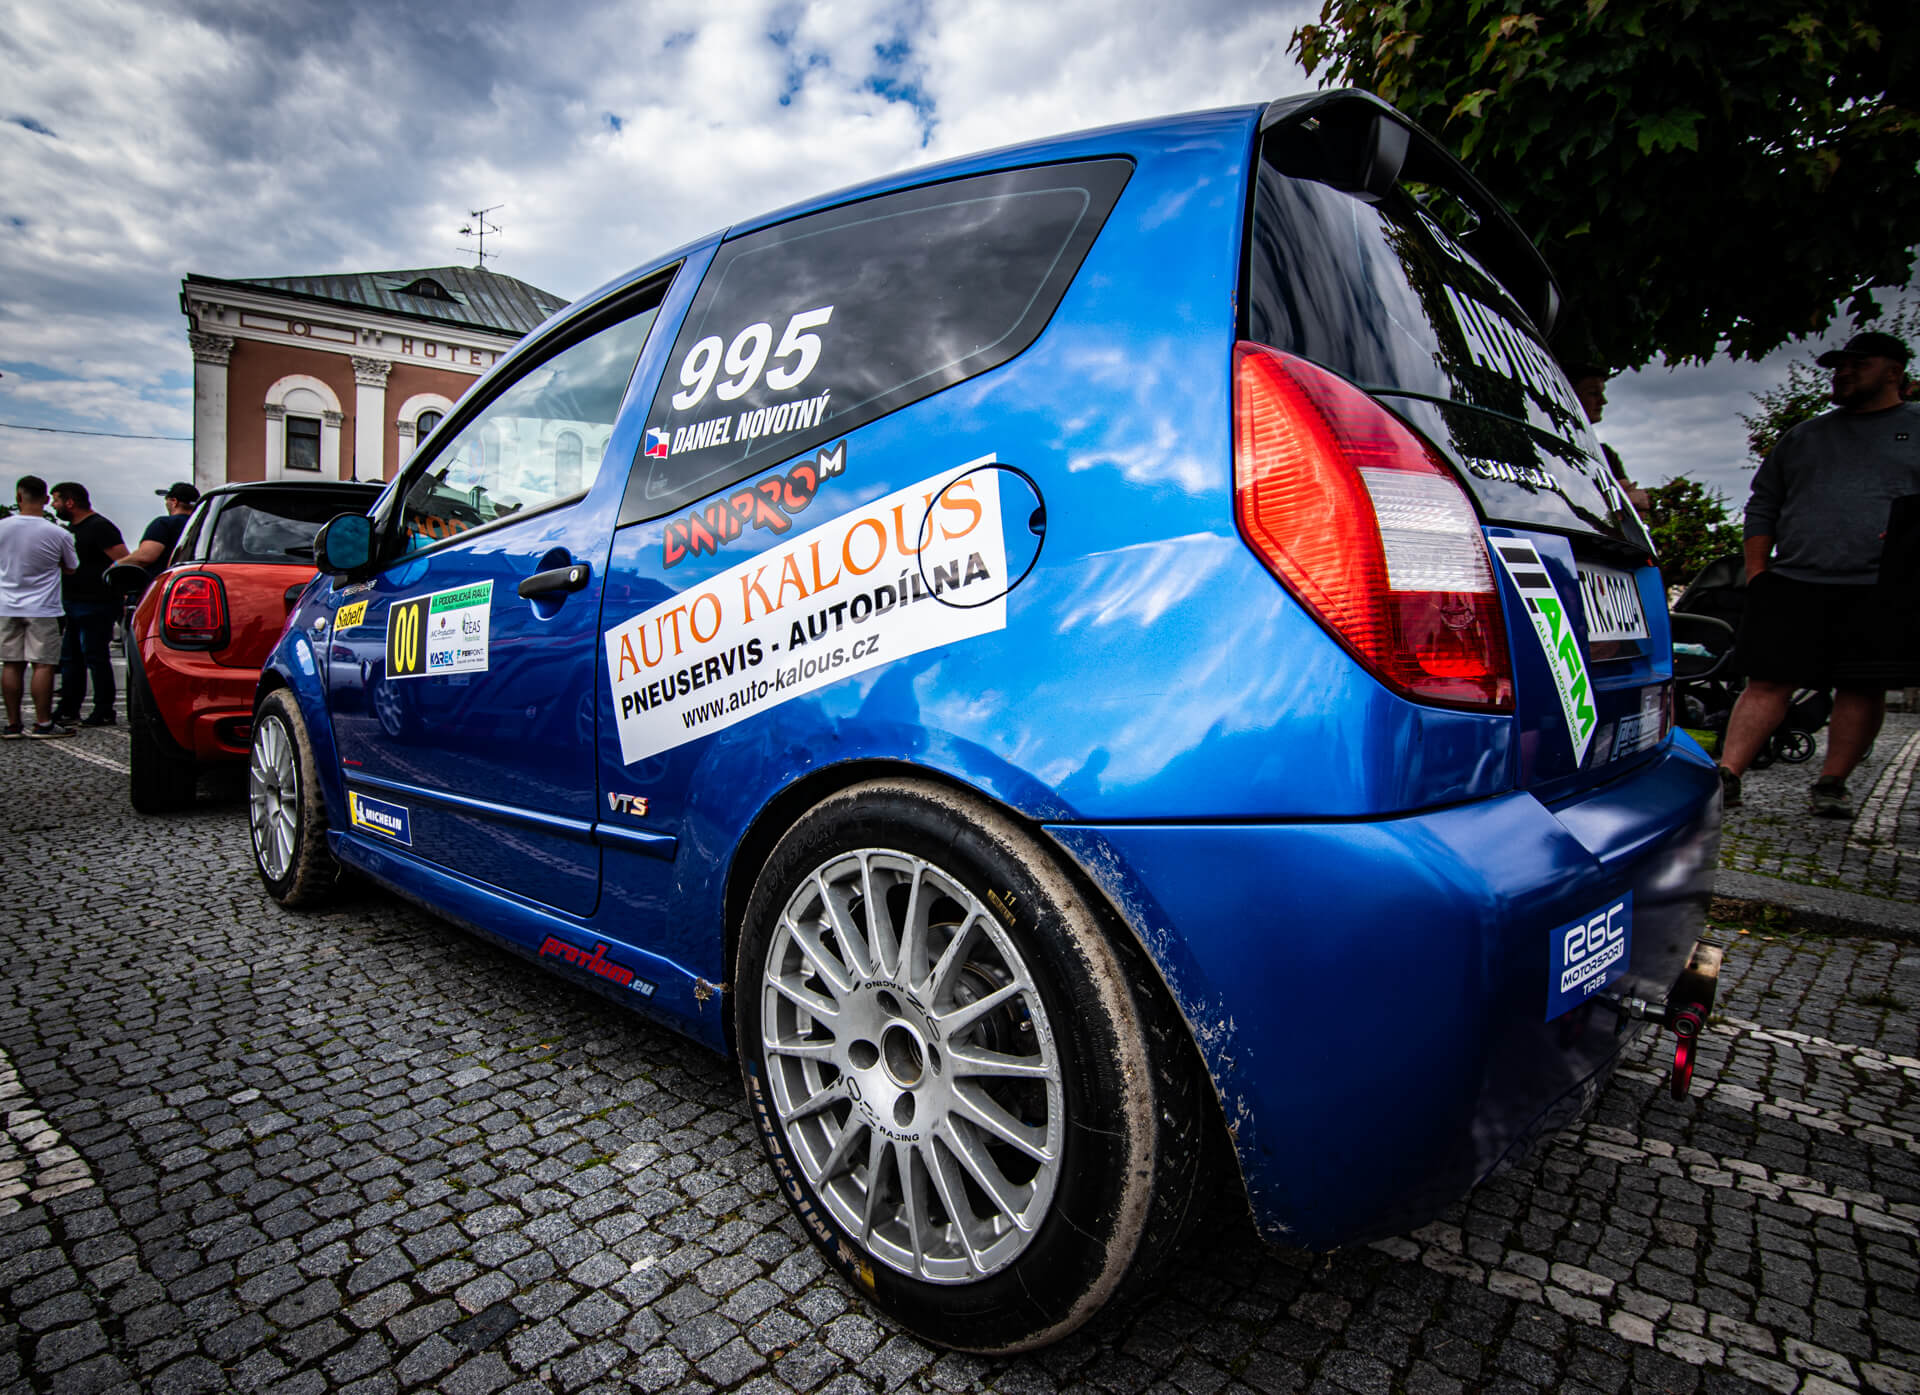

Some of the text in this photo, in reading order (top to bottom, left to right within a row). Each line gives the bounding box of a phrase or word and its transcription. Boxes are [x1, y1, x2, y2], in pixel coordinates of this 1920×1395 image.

[671, 305, 834, 411] 995
[671, 389, 831, 455] DANIEL NOVOTNÝ
[617, 477, 983, 683] AUTO KALOUS
[336, 605, 364, 628] Sabelt
[394, 604, 419, 672] 00
[621, 638, 763, 719] PNEUSERVIS
[788, 552, 991, 650] AUTODÍLNA
[682, 633, 880, 729] www.auto-kalous.cz
[365, 808, 402, 831] MICHELIN
[608, 792, 648, 817] VTS
[1562, 941, 1624, 988] MOTORSPORT
[1564, 902, 1624, 966] RGC
[1583, 972, 1607, 995] TIRES
